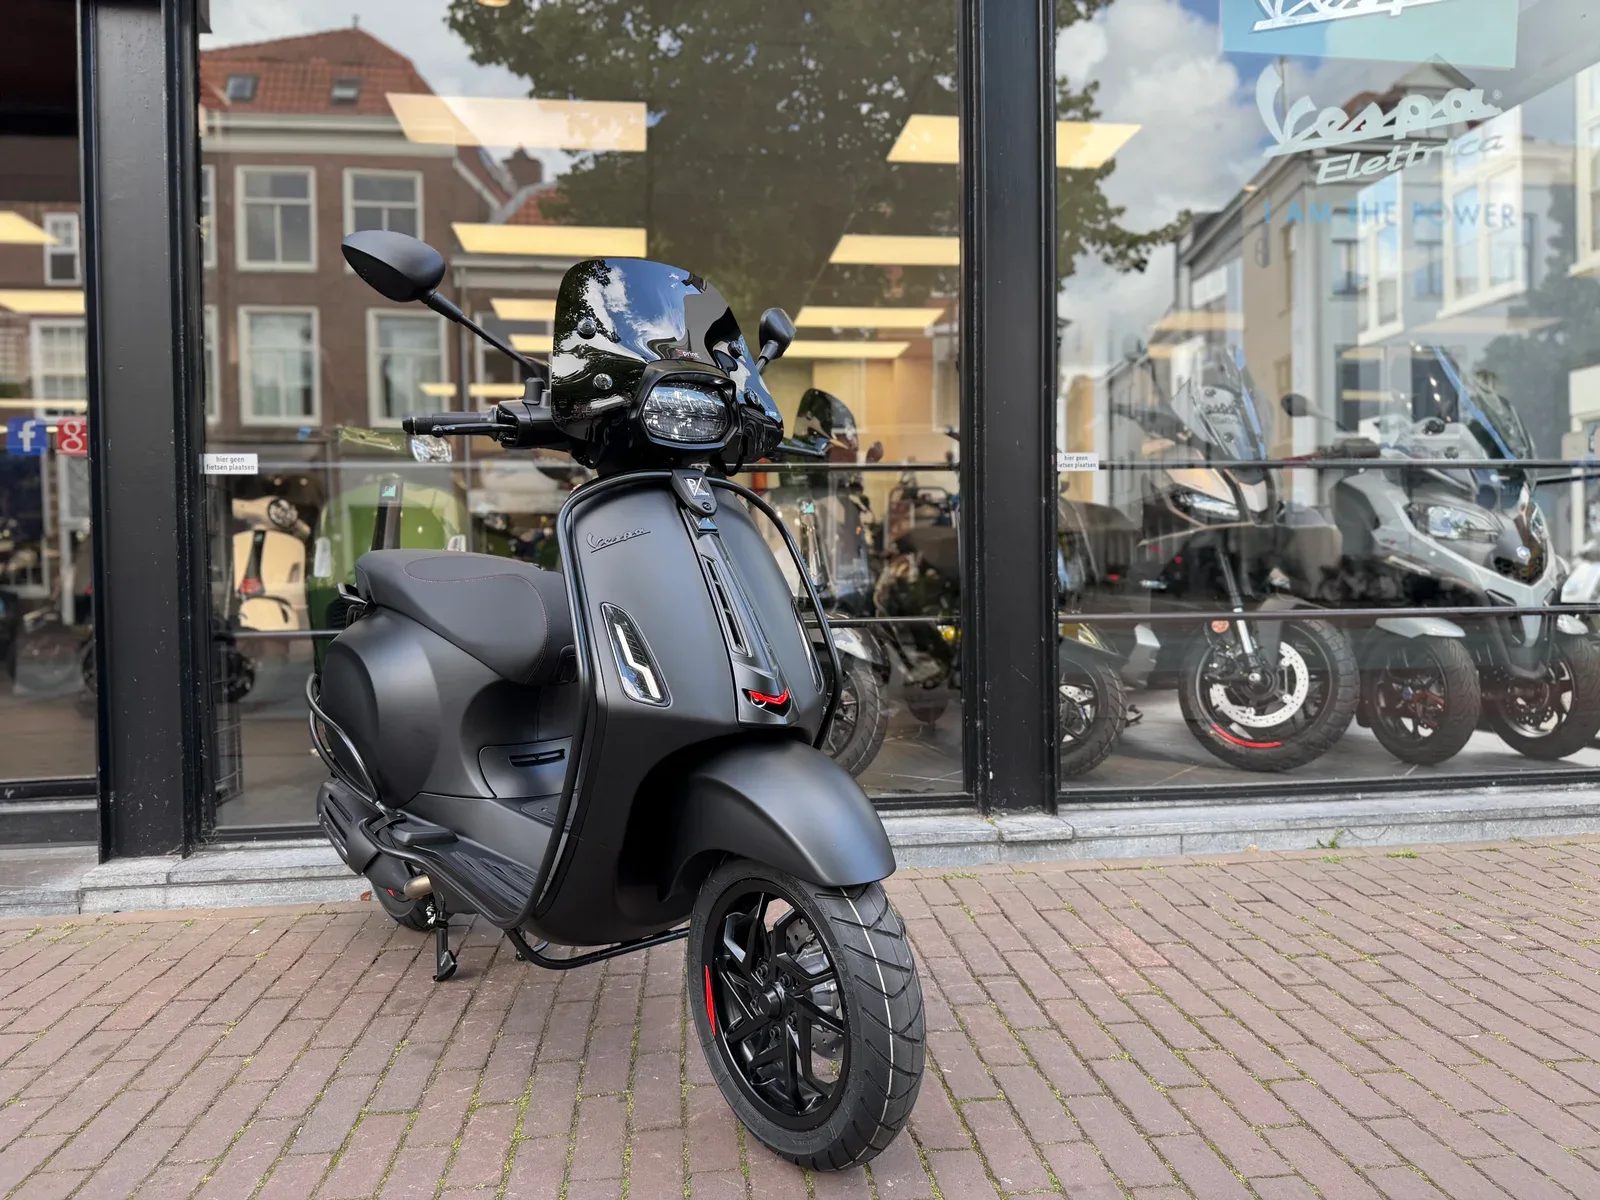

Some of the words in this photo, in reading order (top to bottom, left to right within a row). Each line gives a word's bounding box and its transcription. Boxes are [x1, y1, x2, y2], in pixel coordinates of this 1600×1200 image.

[1256, 64, 1503, 157] Vespa
[1316, 135, 1504, 185] Elettrica
[1285, 201, 1331, 225] AM
[1347, 201, 1396, 227] THE
[1412, 201, 1516, 228] POWER
[586, 528, 651, 553] Vespa
